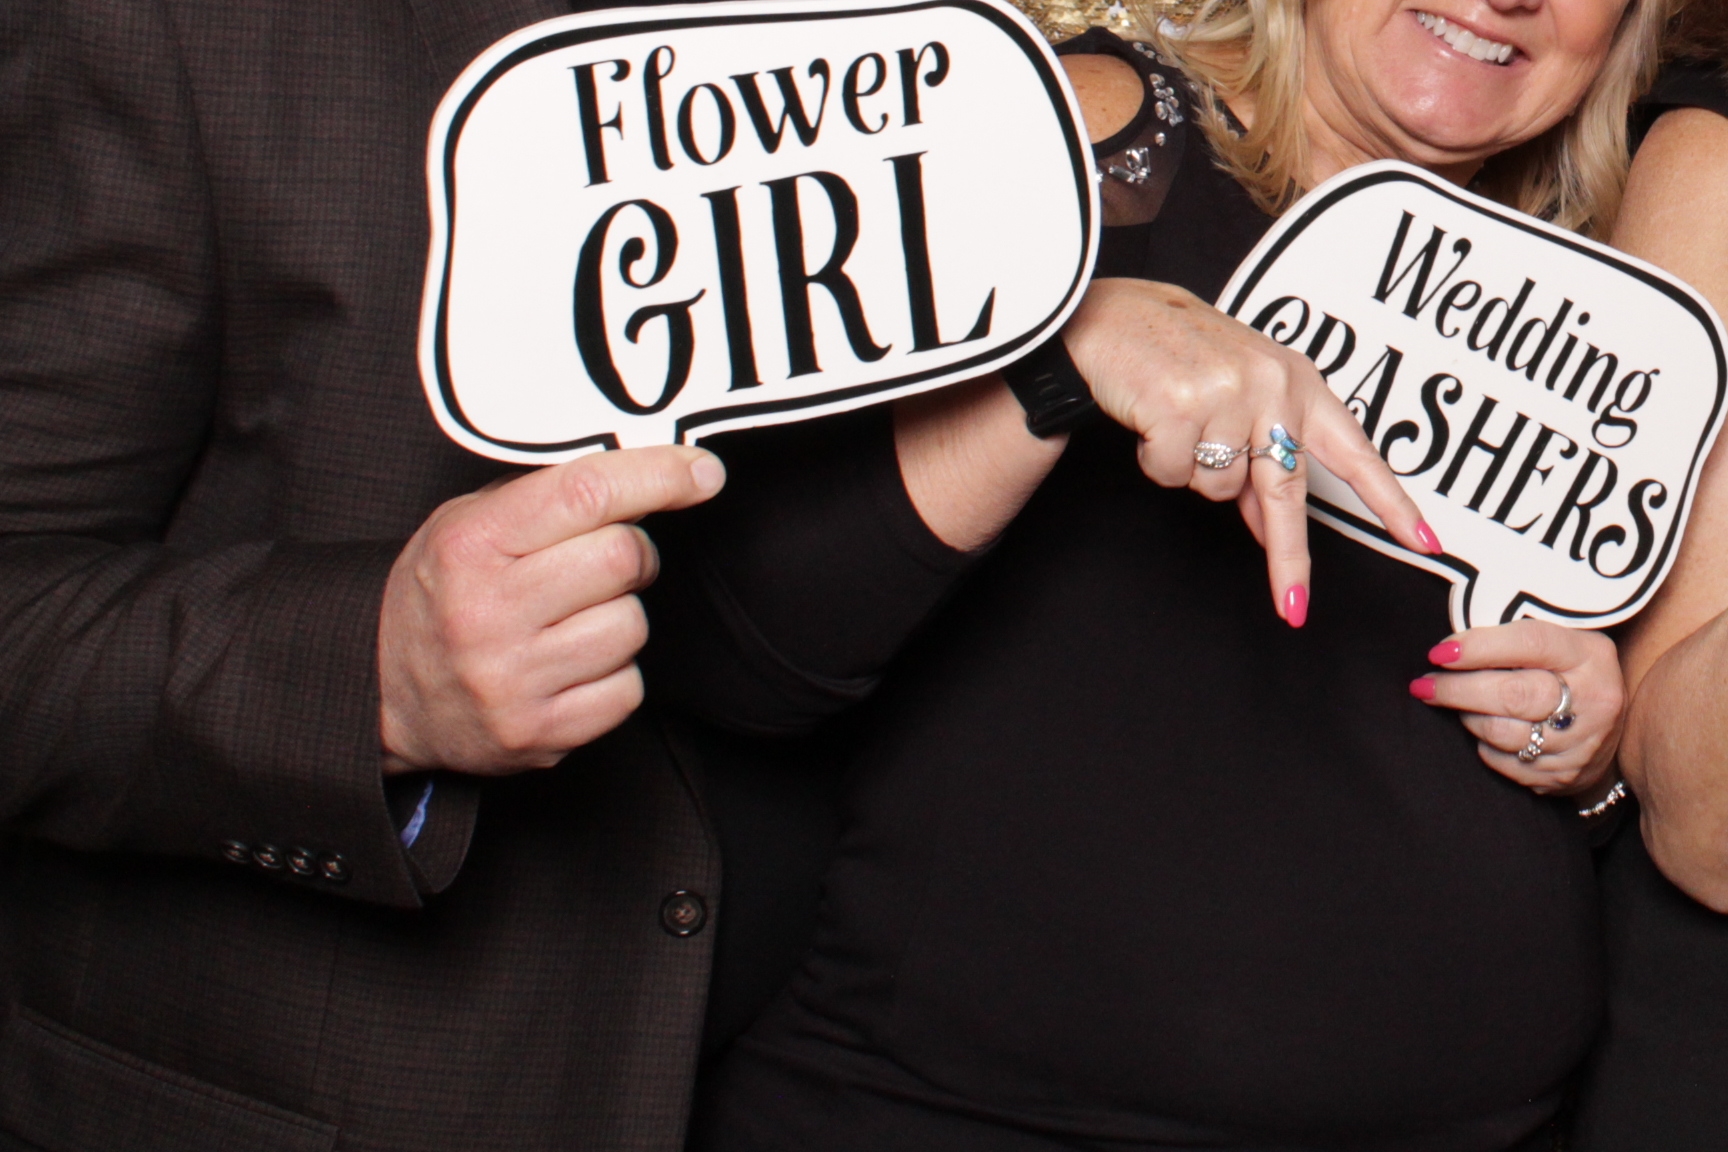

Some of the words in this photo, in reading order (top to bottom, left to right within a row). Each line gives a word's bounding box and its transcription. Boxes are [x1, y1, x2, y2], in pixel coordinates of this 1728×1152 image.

[567, 39, 951, 189] Flower
[571, 150, 997, 417] GIRL
[1371, 208, 1662, 449] Wedding
